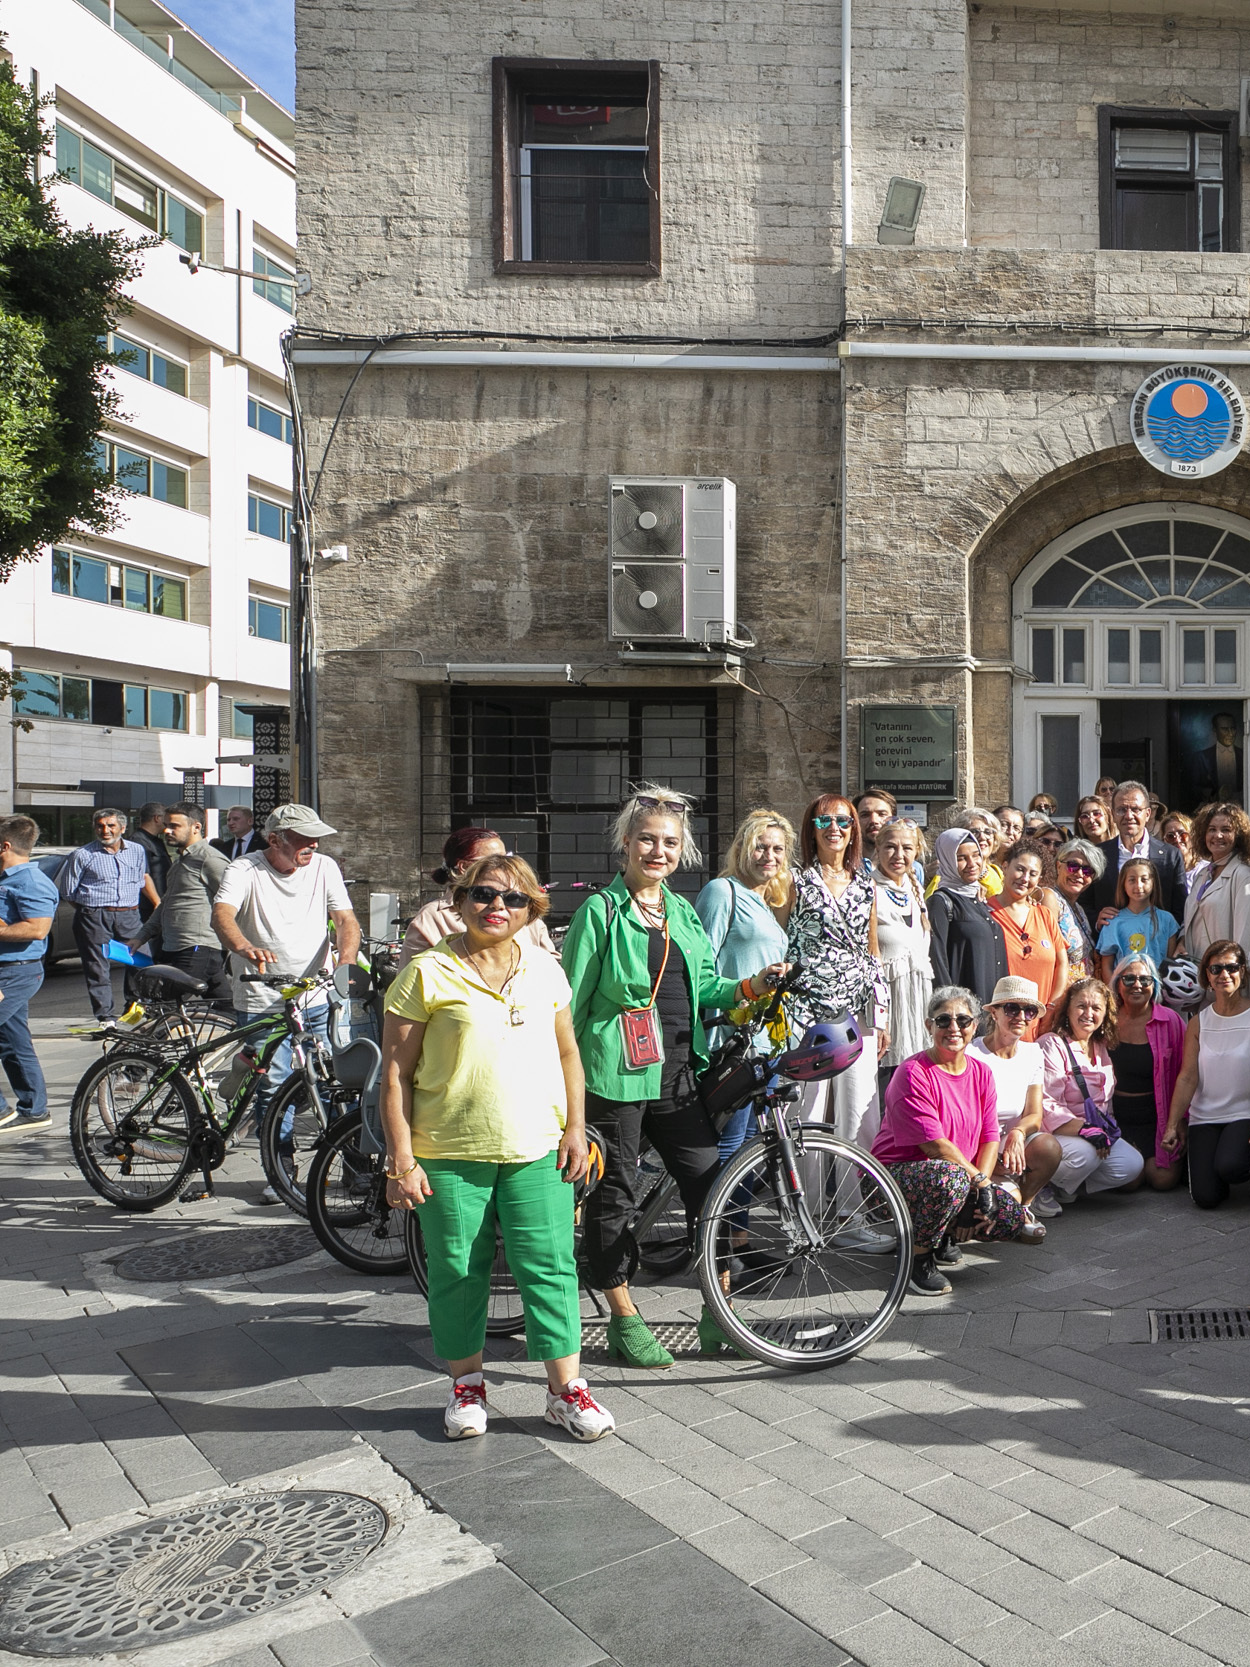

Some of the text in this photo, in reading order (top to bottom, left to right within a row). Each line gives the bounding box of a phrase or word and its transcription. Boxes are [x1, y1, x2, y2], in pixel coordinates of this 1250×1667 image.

[1145, 366, 1217, 394] BÜYÜKŞEHİR
[1178, 464, 1197, 472] 1873
[697, 482, 723, 492] arçelik
[875, 735, 887, 743] en
[889, 734, 904, 745] çok
[875, 746, 912, 757] görevini
[875, 759, 887, 767] en
